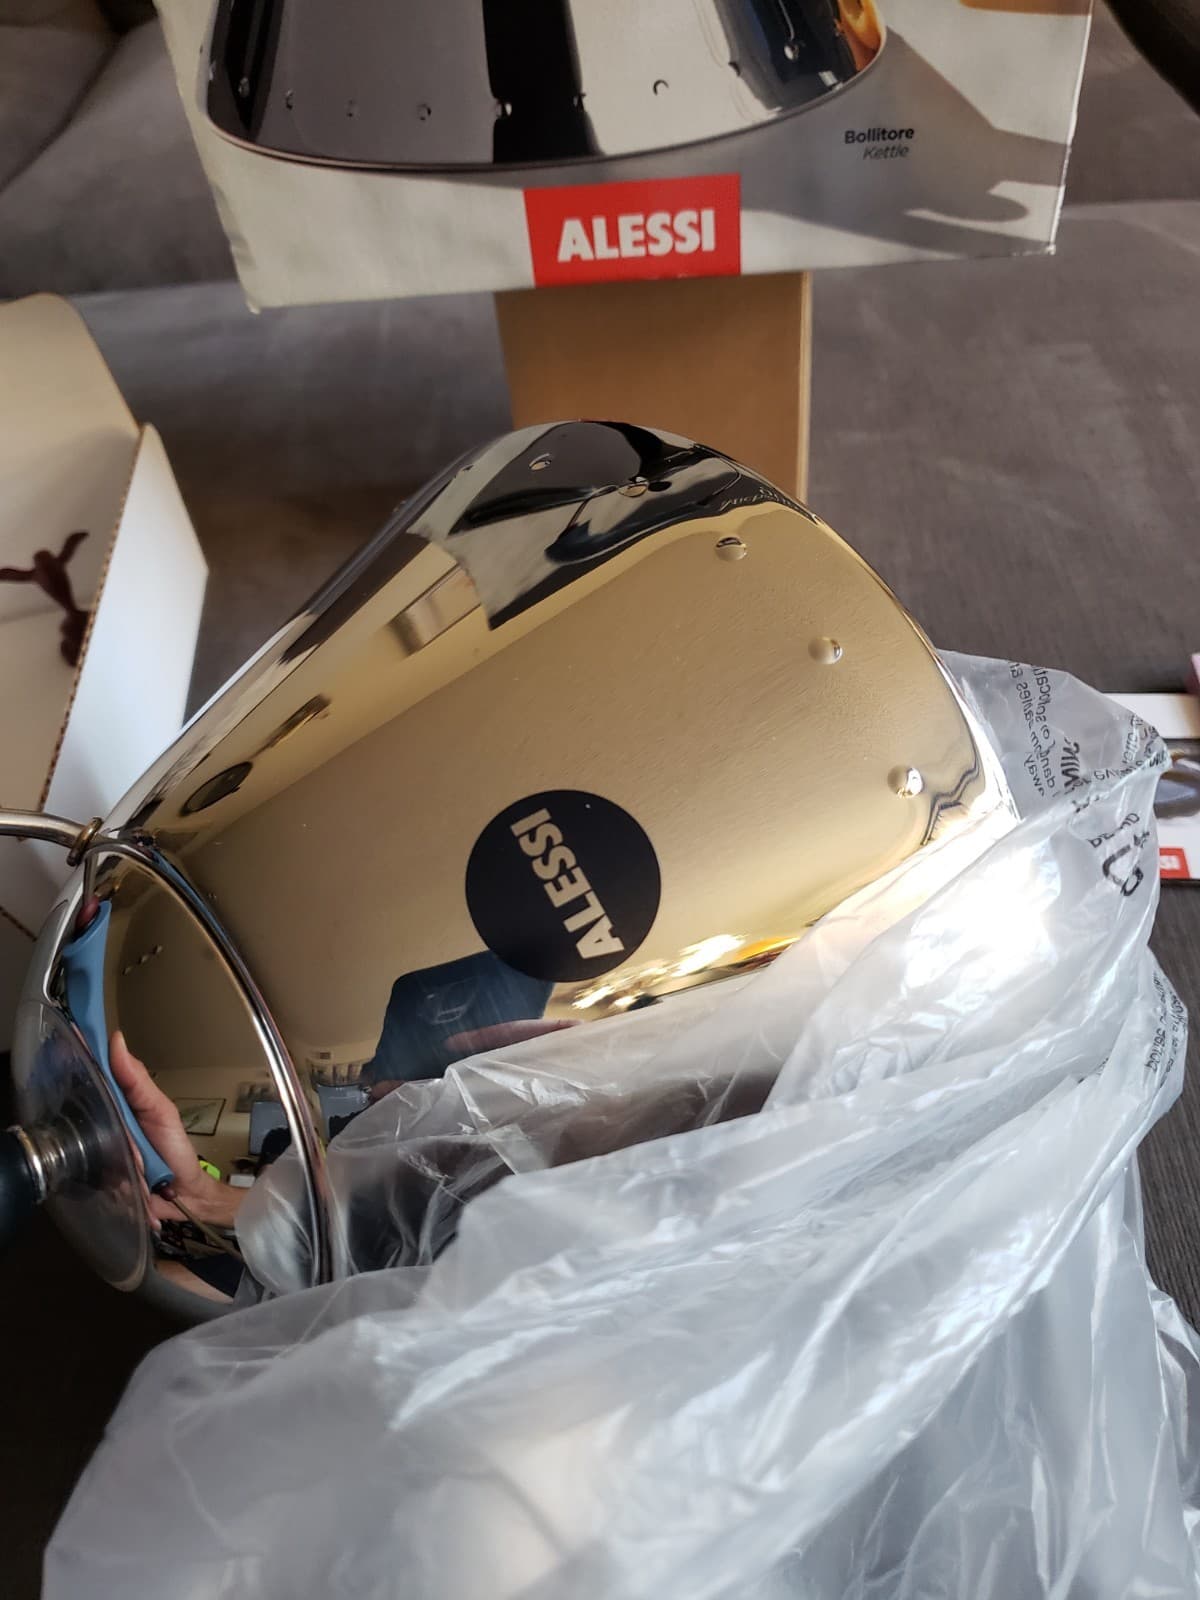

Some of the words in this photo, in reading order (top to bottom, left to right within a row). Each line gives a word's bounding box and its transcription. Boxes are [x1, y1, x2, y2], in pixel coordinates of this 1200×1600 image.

[844, 127, 915, 144] Bollitore
[863, 145, 909, 160] Kettle
[557, 208, 716, 263] ALESSI
[510, 807, 625, 960] ALESSI
